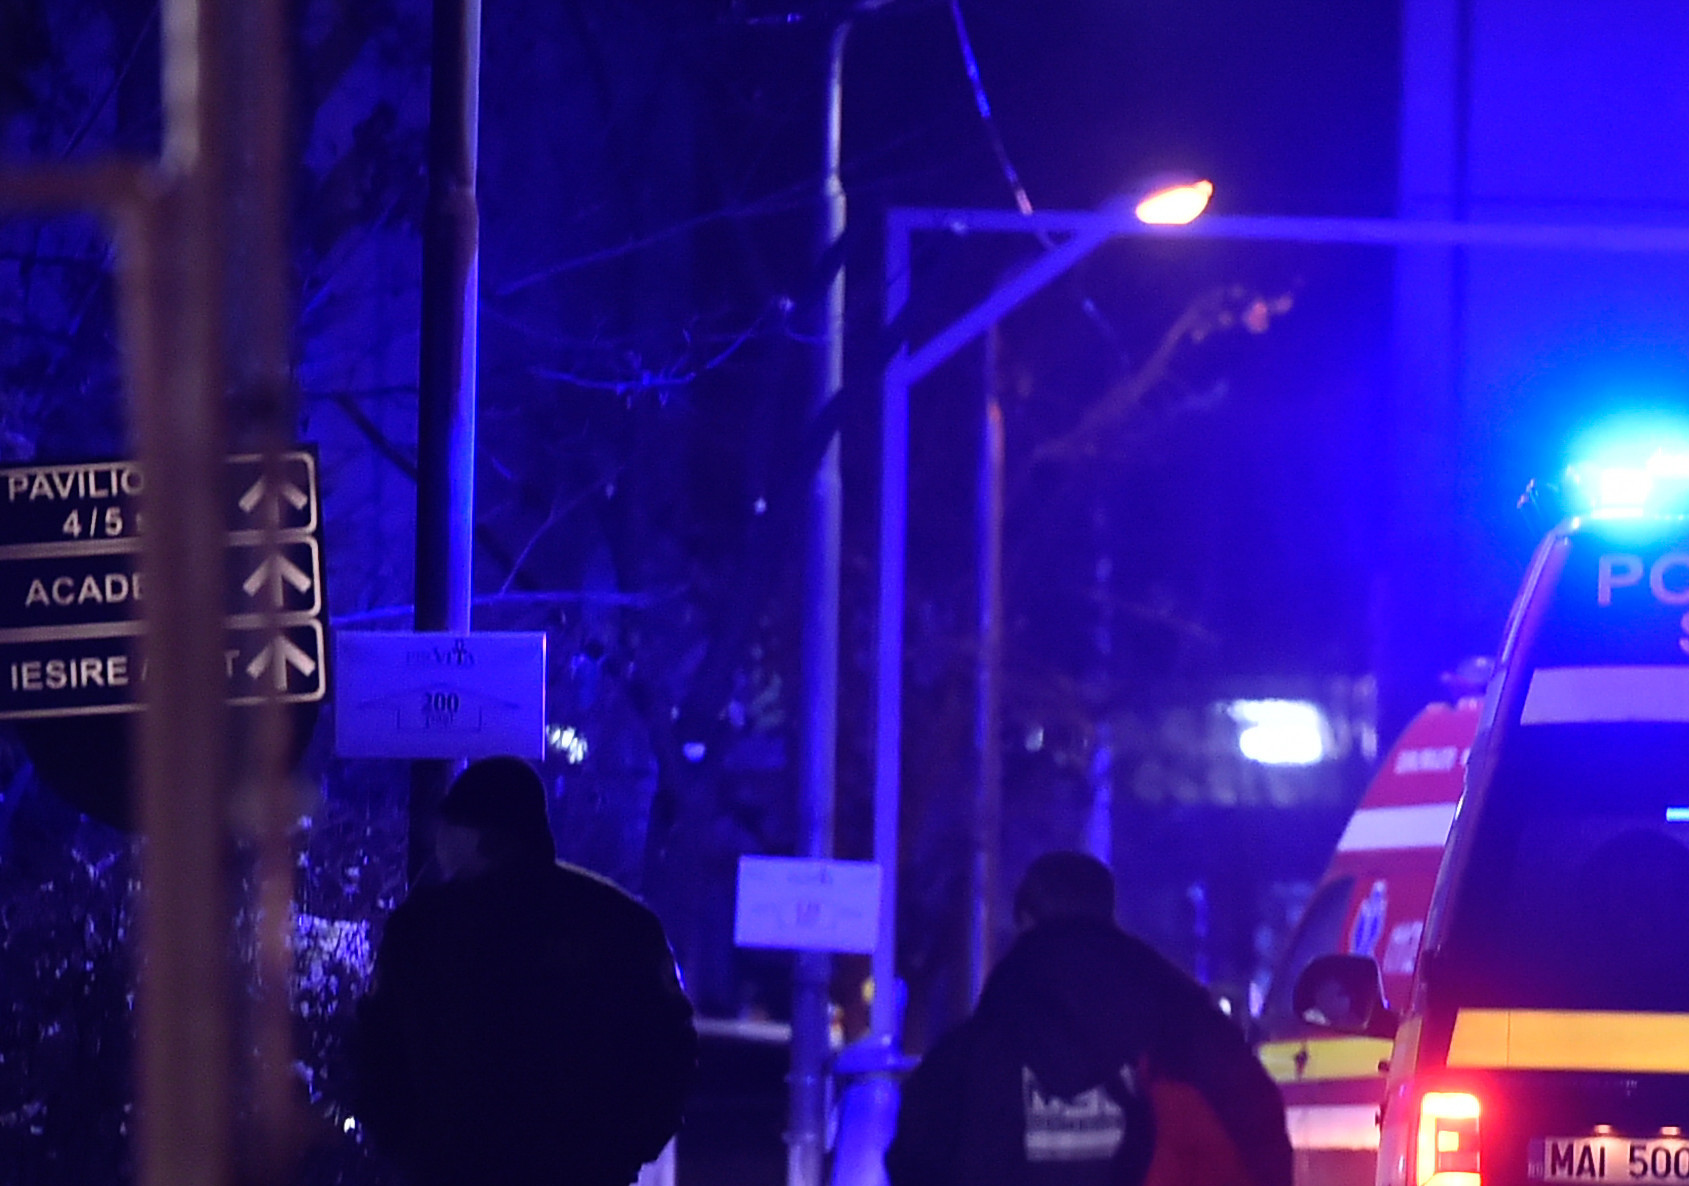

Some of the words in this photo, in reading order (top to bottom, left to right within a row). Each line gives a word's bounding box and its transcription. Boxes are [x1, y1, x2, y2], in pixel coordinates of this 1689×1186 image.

[7, 469, 147, 503] PAVILIO
[10, 655, 129, 692] IESIRE
[1549, 1142, 1606, 1178] MAI
